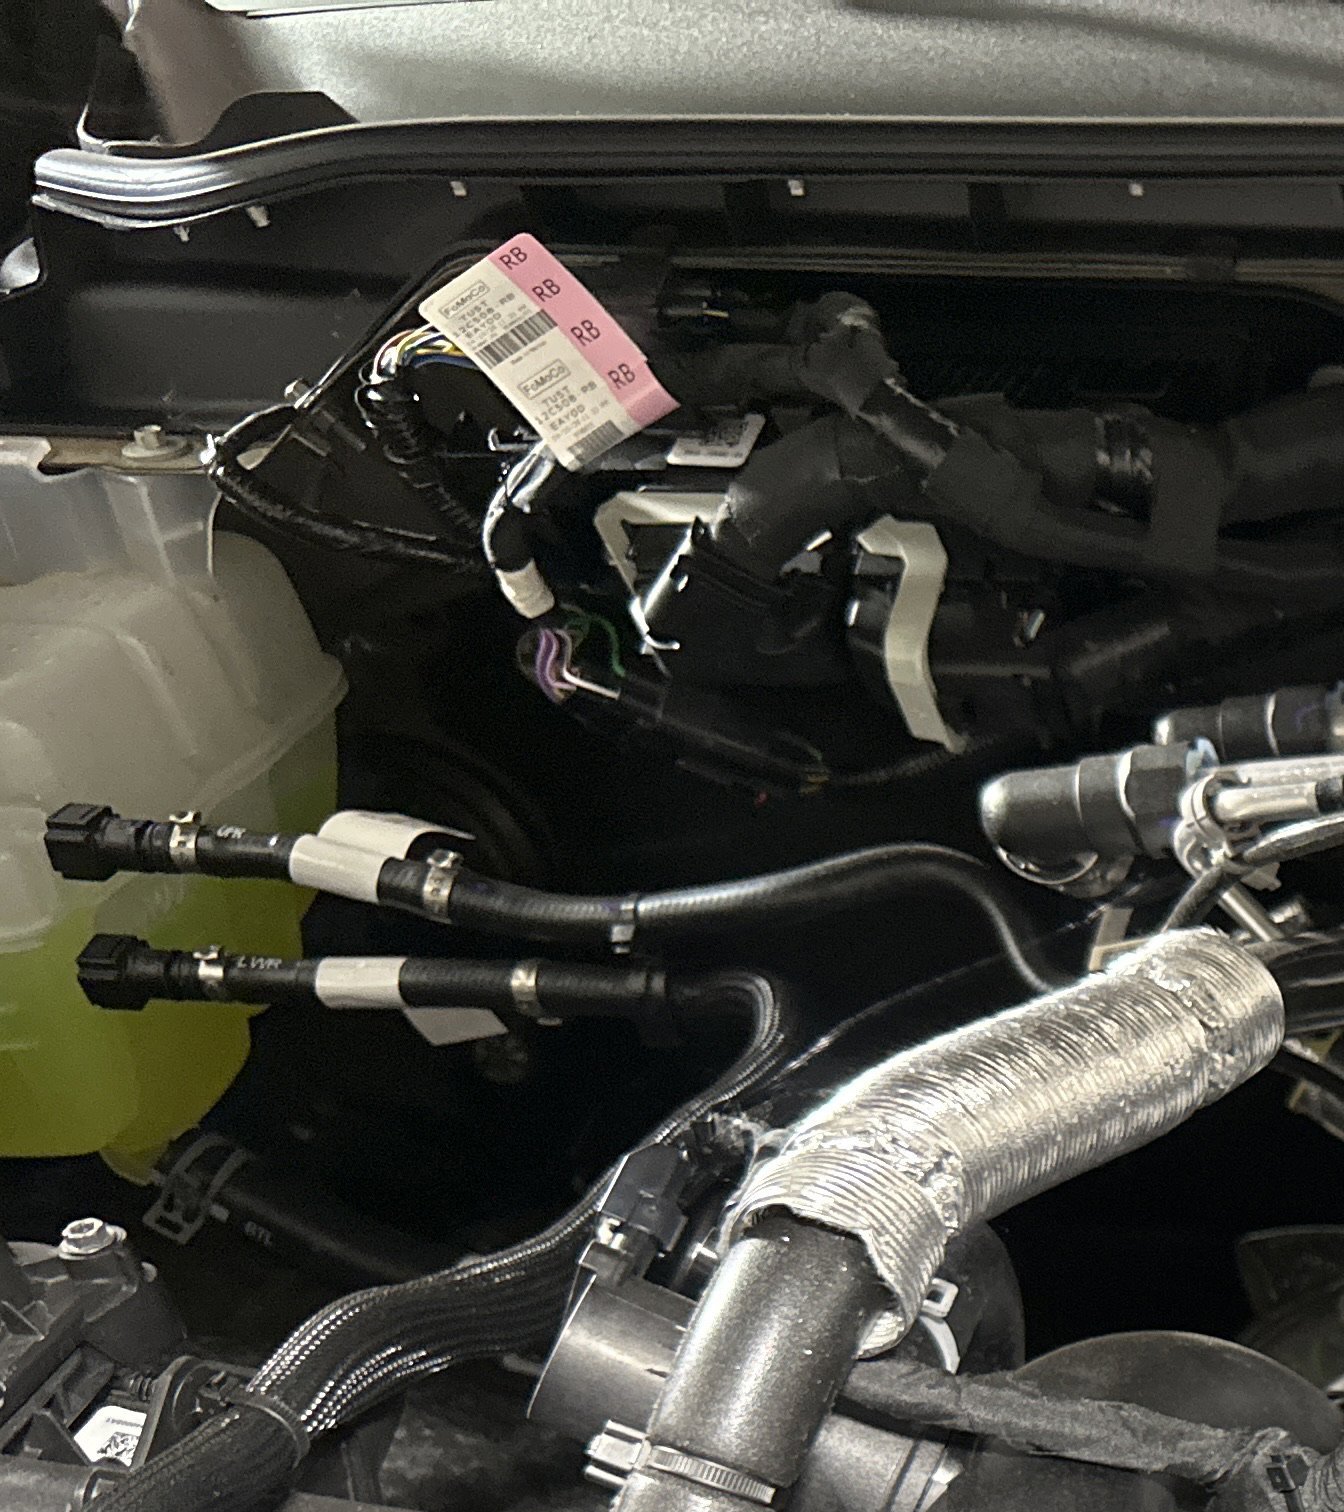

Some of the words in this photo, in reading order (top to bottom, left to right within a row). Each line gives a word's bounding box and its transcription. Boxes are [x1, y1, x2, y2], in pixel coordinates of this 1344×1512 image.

[500, 247, 528, 270] RB
[444, 284, 486, 317] FoMoCo
[532, 278, 561, 302] RB
[570, 319, 601, 346] RB
[522, 365, 566, 396] FoMoCo
[608, 363, 636, 390] RB
